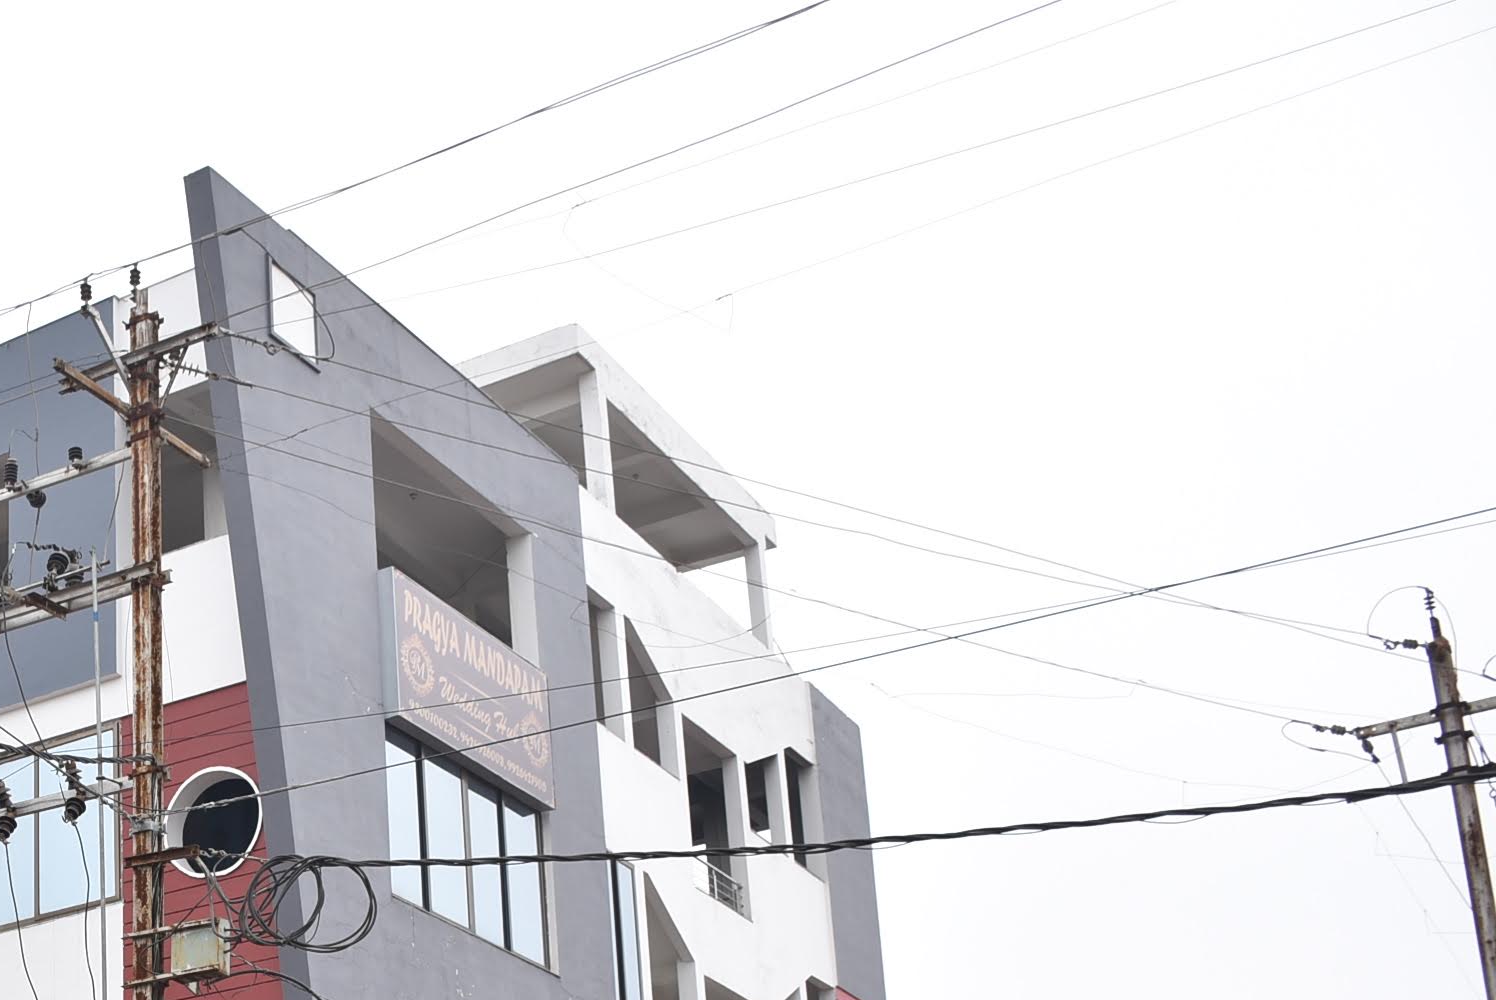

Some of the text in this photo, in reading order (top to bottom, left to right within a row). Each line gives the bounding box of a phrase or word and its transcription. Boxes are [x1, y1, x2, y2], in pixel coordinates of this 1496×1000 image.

[403, 589, 544, 713] PRAGYA MANDAPAM
[438, 676, 493, 732] Wedding
